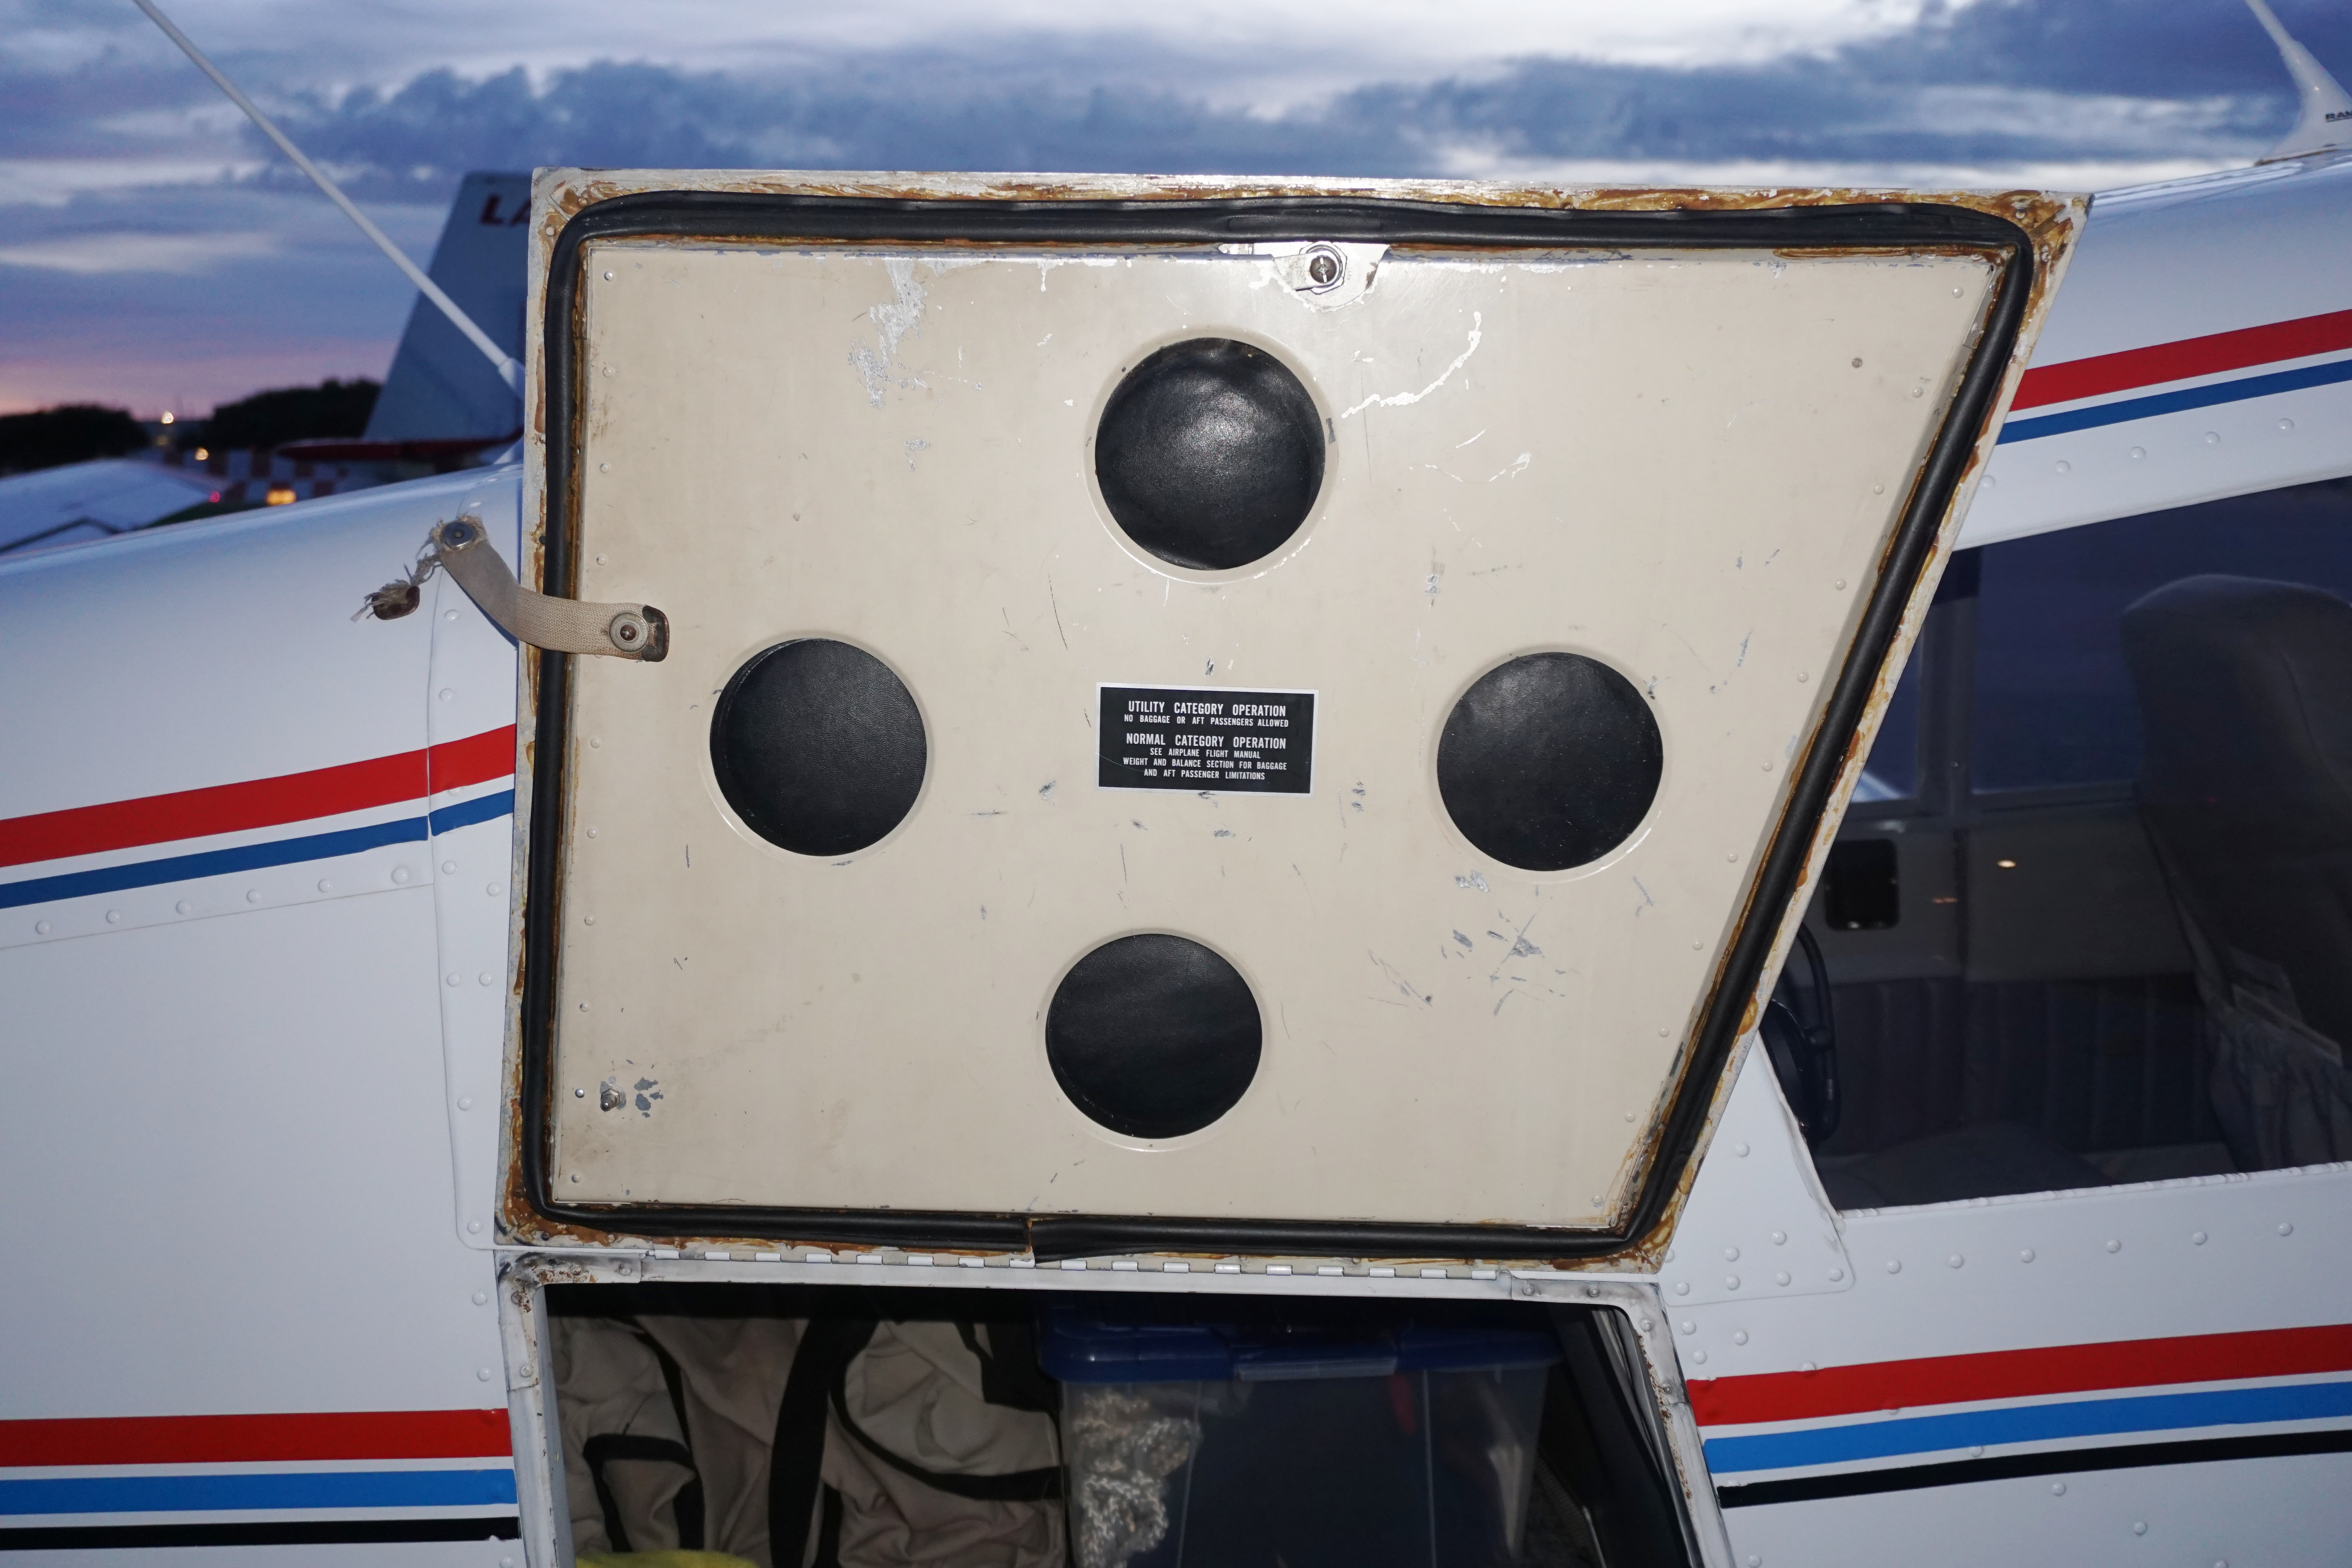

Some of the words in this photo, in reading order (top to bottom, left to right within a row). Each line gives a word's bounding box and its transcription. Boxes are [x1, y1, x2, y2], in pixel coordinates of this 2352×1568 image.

[1129, 701, 1165, 713] UTILITY
[1174, 702, 1224, 715] CATEGORY
[1232, 704, 1286, 717] OPERATION
[1124, 714, 1133, 722] NO
[1140, 715, 1171, 724] BAGGAGE
[1176, 716, 1185, 724] OR
[1192, 717, 1205, 725] AFT
[1210, 717, 1254, 726] PASSENGERS
[1257, 719, 1289, 727] ALLOWED
[1126, 733, 1166, 745] NORMAL
[1175, 735, 1224, 747] CATEGORY
[1233, 737, 1286, 749] OPERATION
[1150, 748, 1162, 756] SEE
[1168, 748, 1200, 757] AIRPLANE
[1206, 749, 1229, 758] FLIGHT
[1234, 750, 1261, 759] MANUAL
[1123, 757, 1148, 766] WEIGHT
[1172, 759, 1201, 768] BALANCE
[1206, 760, 1234, 768] SECTION
[1239, 761, 1252, 769] FOR
[1257, 762, 1287, 770] BAGGAGE
[1143, 768, 1157, 777] AND
[1181, 769, 1220, 779] PASSENGER
[1225, 771, 1265, 780] LIMITATIONS
